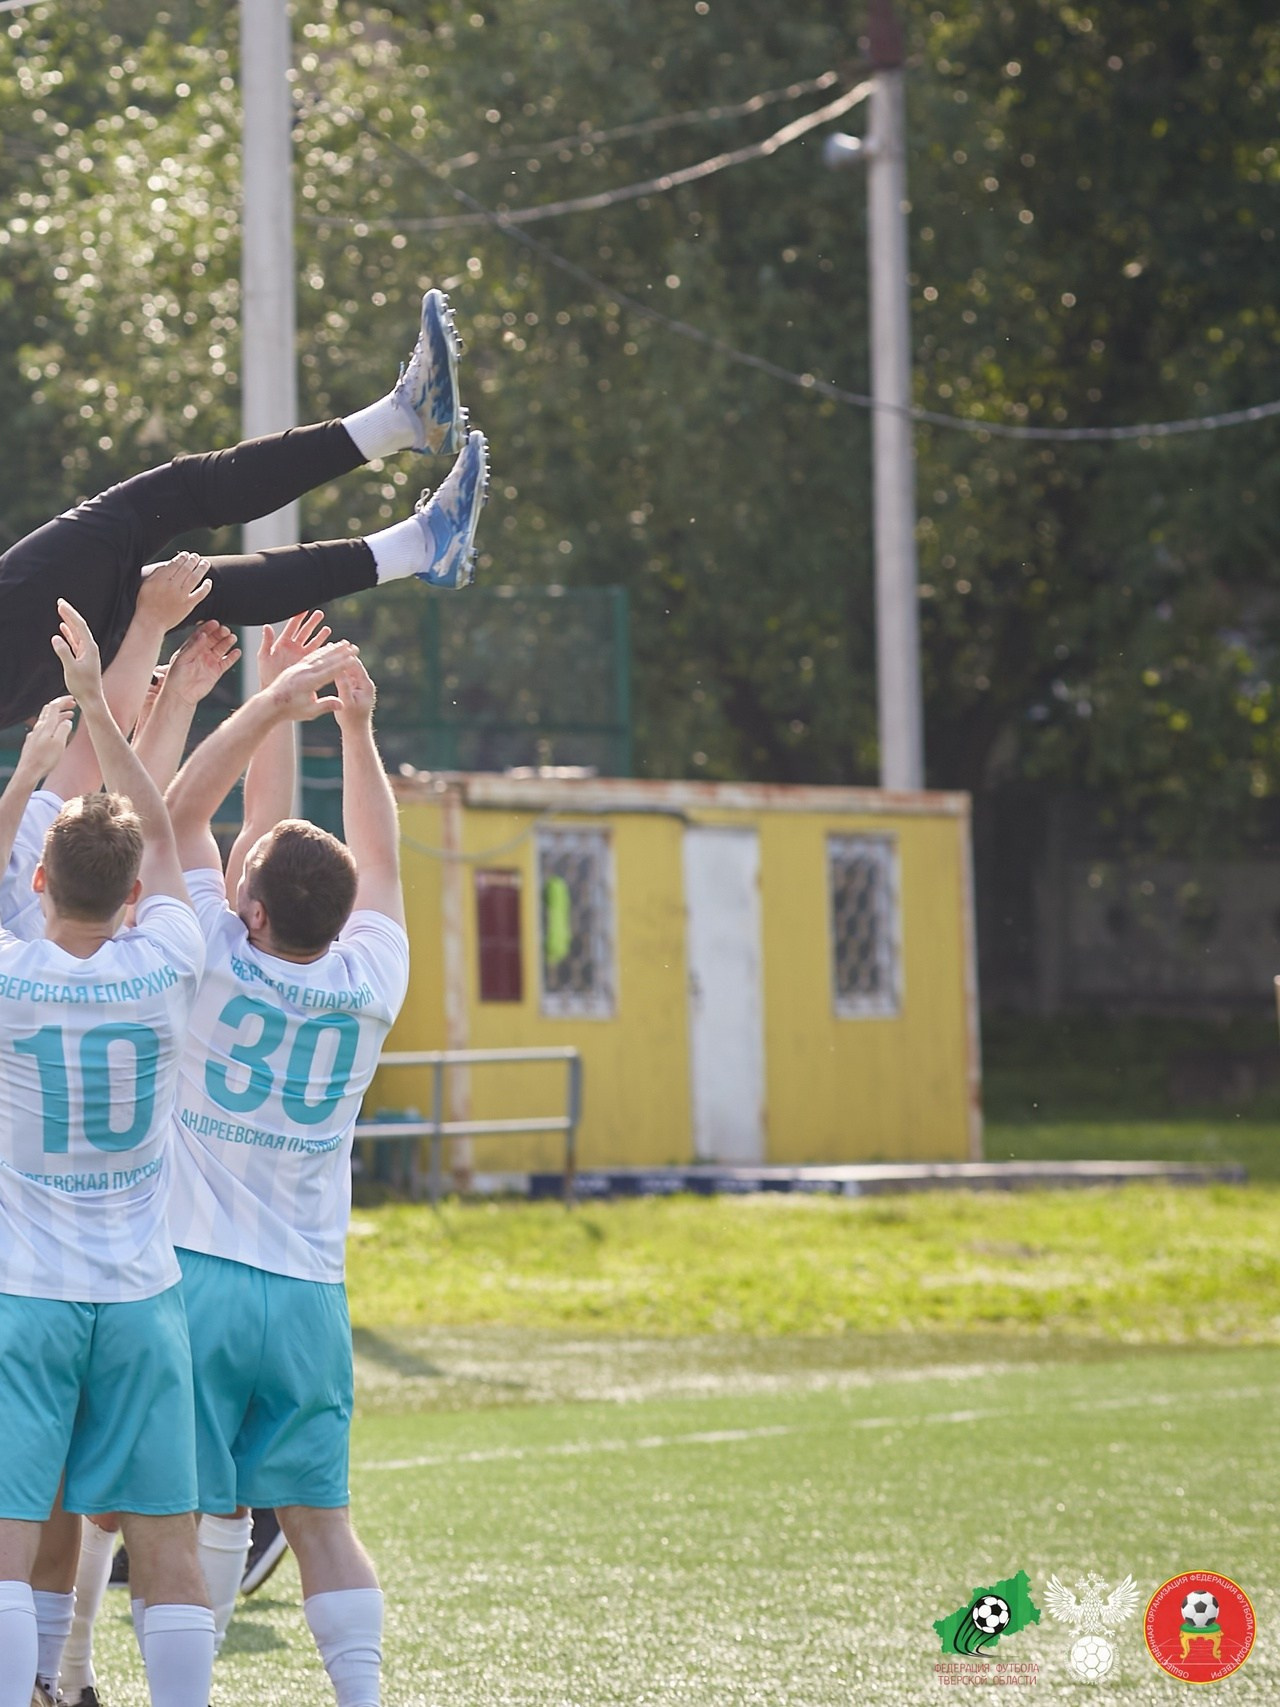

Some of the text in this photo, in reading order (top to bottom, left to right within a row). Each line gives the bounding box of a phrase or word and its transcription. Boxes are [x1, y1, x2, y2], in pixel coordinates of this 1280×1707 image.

[95, 964, 179, 1004] ЕПАРХИЯ
[13, 1022, 160, 1153] 10
[205, 994, 360, 1125] 30
[181, 1108, 286, 1150] АНДРЕЕВСКАЯ
